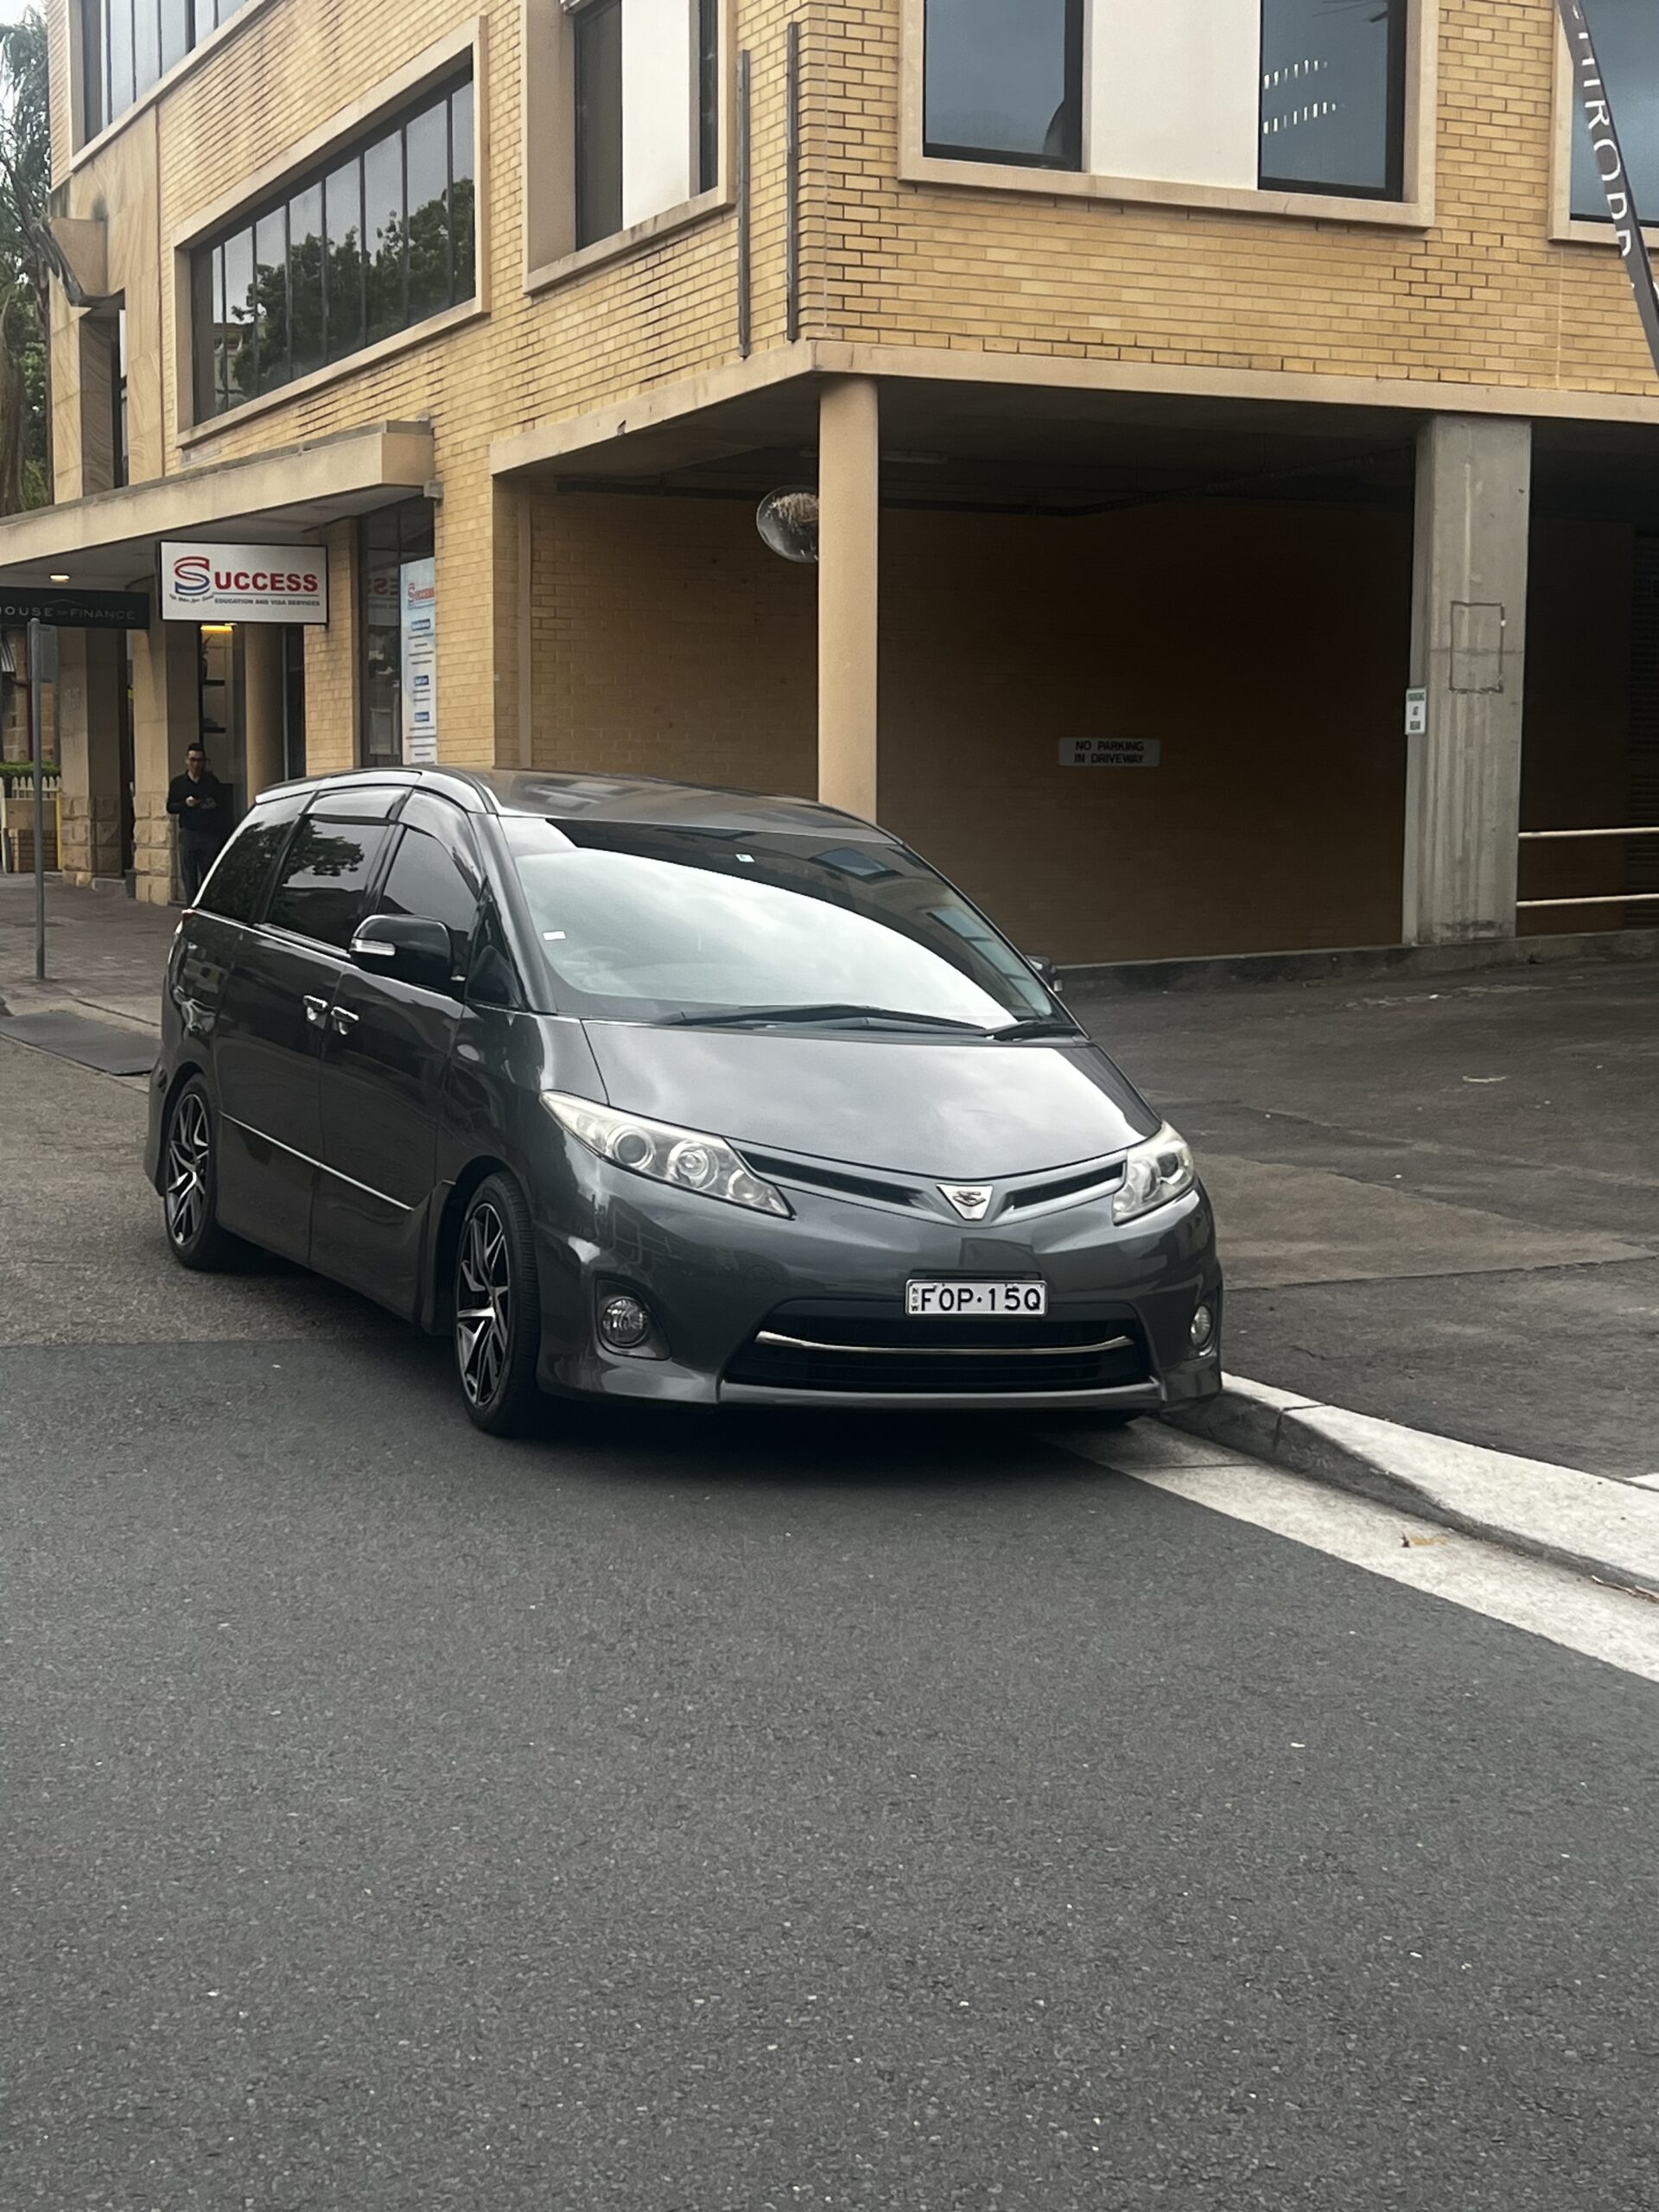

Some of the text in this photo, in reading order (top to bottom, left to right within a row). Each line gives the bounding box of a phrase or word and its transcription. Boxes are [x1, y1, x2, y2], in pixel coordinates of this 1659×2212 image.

[174, 556, 318, 595] SUCCESS
[0, 606, 54, 617] OUSE
[70, 607, 136, 620] FINANCE
[1075, 740, 1144, 751] NO PARKING
[1074, 753, 1144, 764] IN DRIVEWAY
